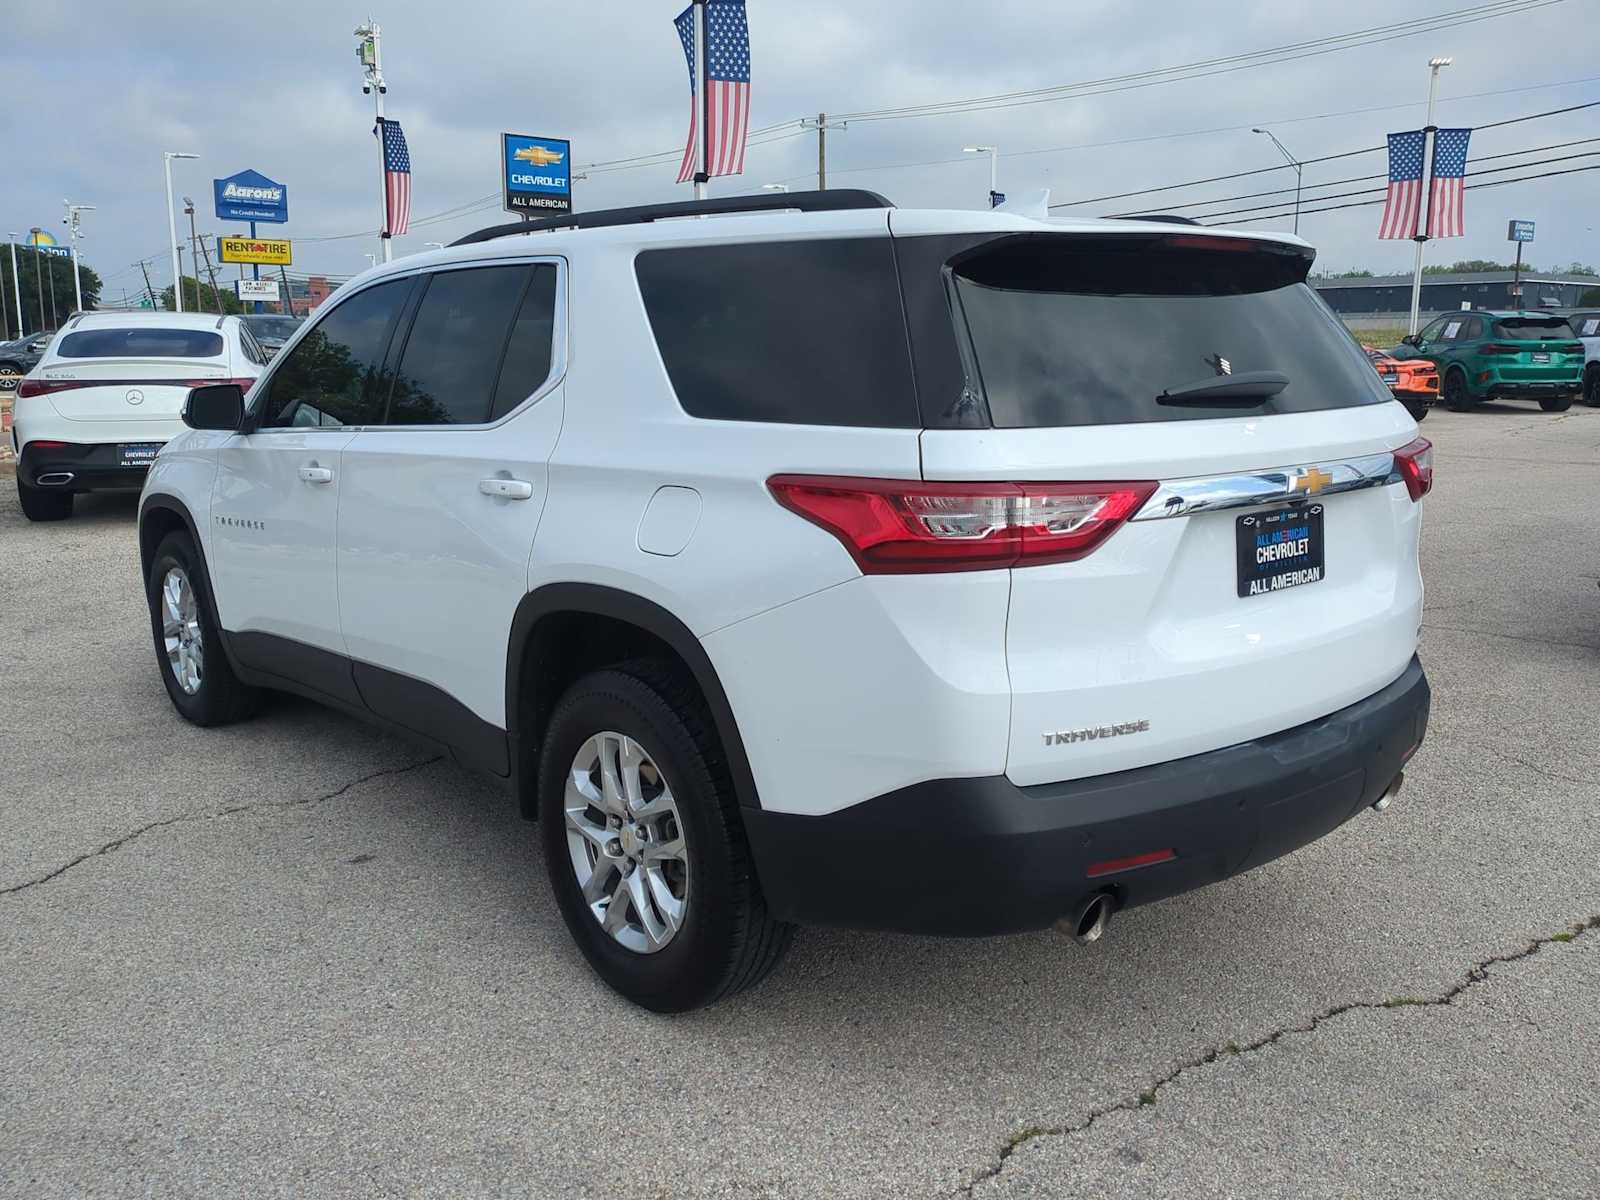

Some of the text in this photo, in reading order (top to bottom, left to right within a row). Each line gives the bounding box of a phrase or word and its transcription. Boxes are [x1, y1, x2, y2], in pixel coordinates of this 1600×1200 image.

[511, 174, 567, 187] CHEVROLET
[224, 183, 281, 200] Aaron's
[512, 197, 568, 209] ALL AMERICAN
[226, 242, 254, 252] RENT
[262, 243, 287, 254] TIRE
[215, 516, 265, 530] TRAVERSE
[1257, 527, 1309, 546] ALL AMERICAN
[1256, 539, 1309, 563] CHEVROLET
[1250, 567, 1320, 595] ALL AMERICAN
[1042, 719, 1151, 746] TRAVERSE
